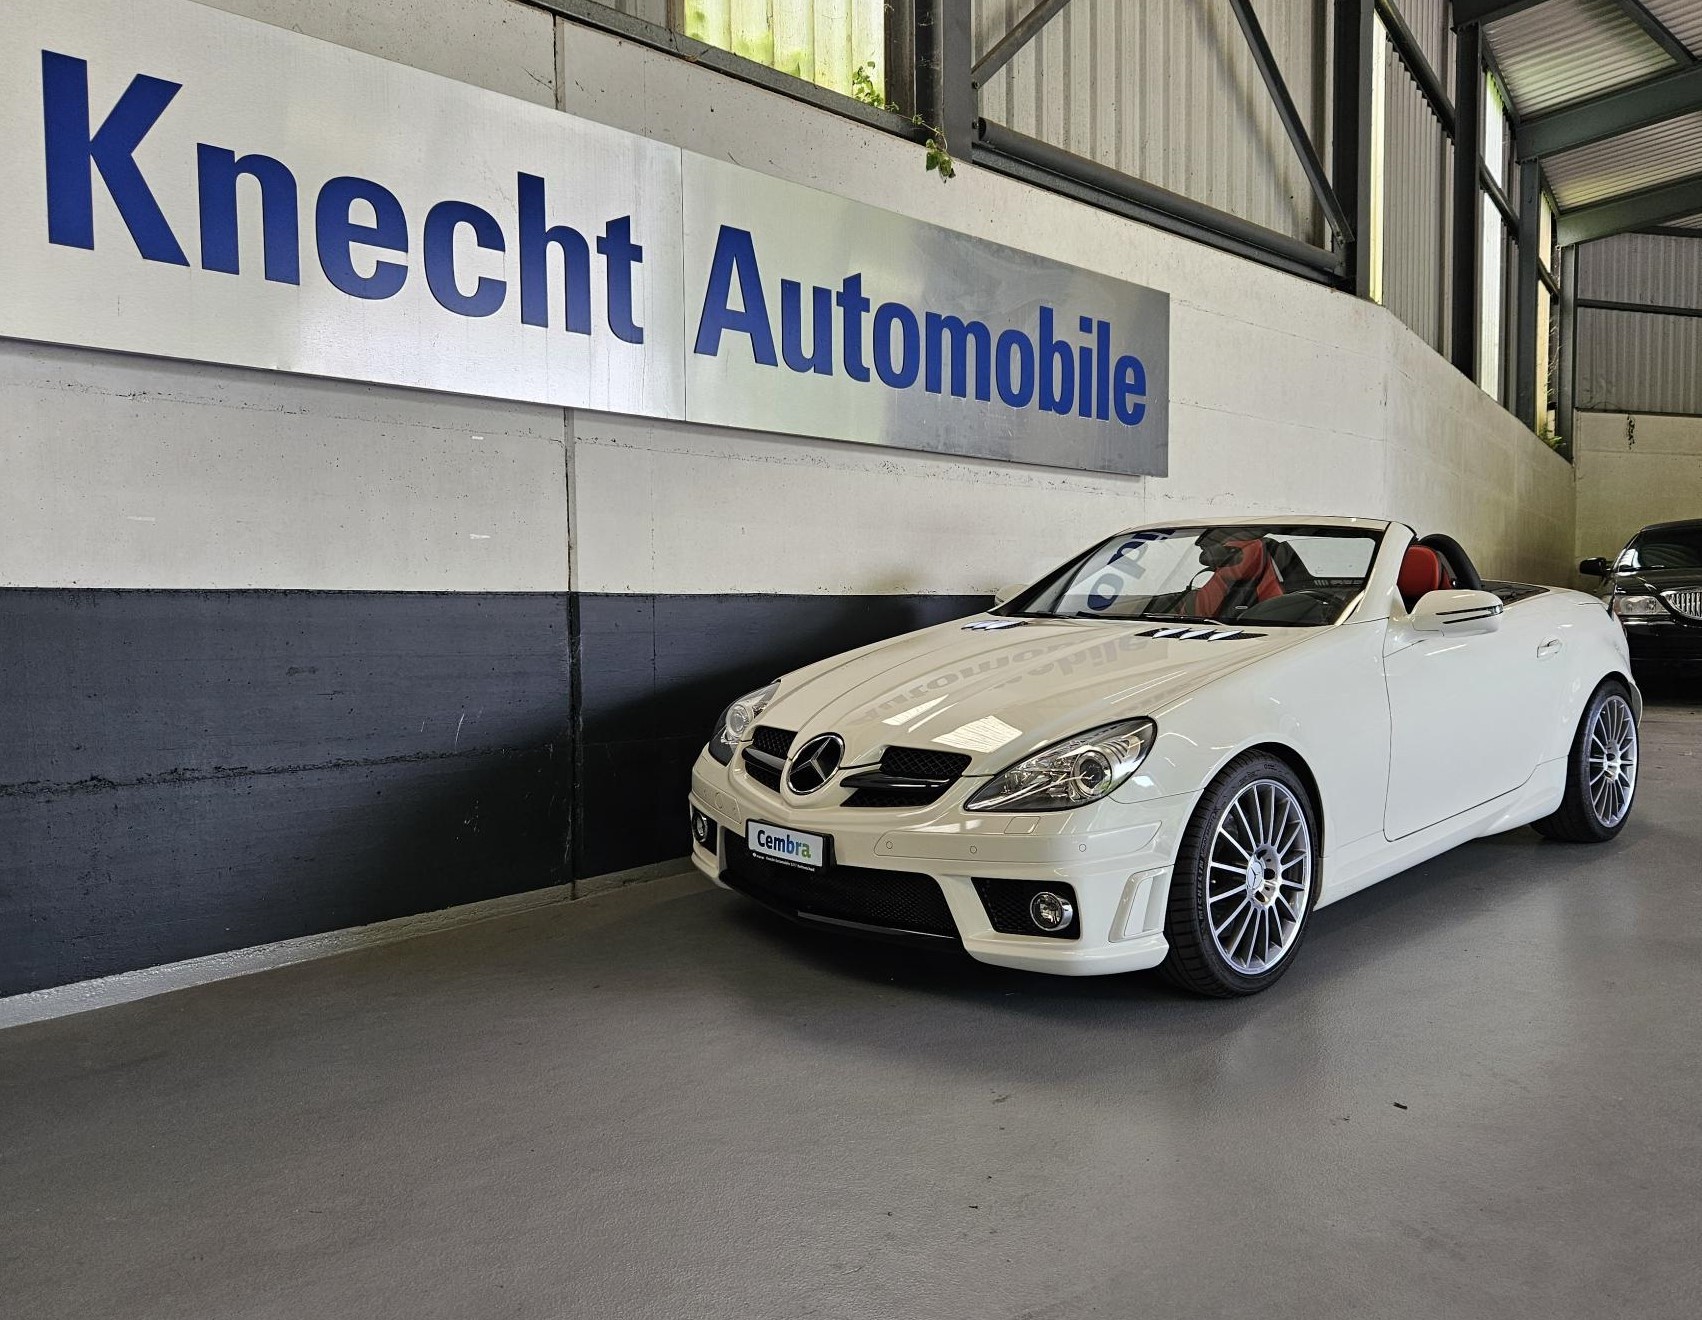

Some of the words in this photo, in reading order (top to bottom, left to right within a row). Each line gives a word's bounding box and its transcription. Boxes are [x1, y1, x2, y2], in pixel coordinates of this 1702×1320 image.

[41, 49, 644, 345] Knecht
[693, 224, 1147, 427] Automobile
[757, 830, 812, 859] Cembra
